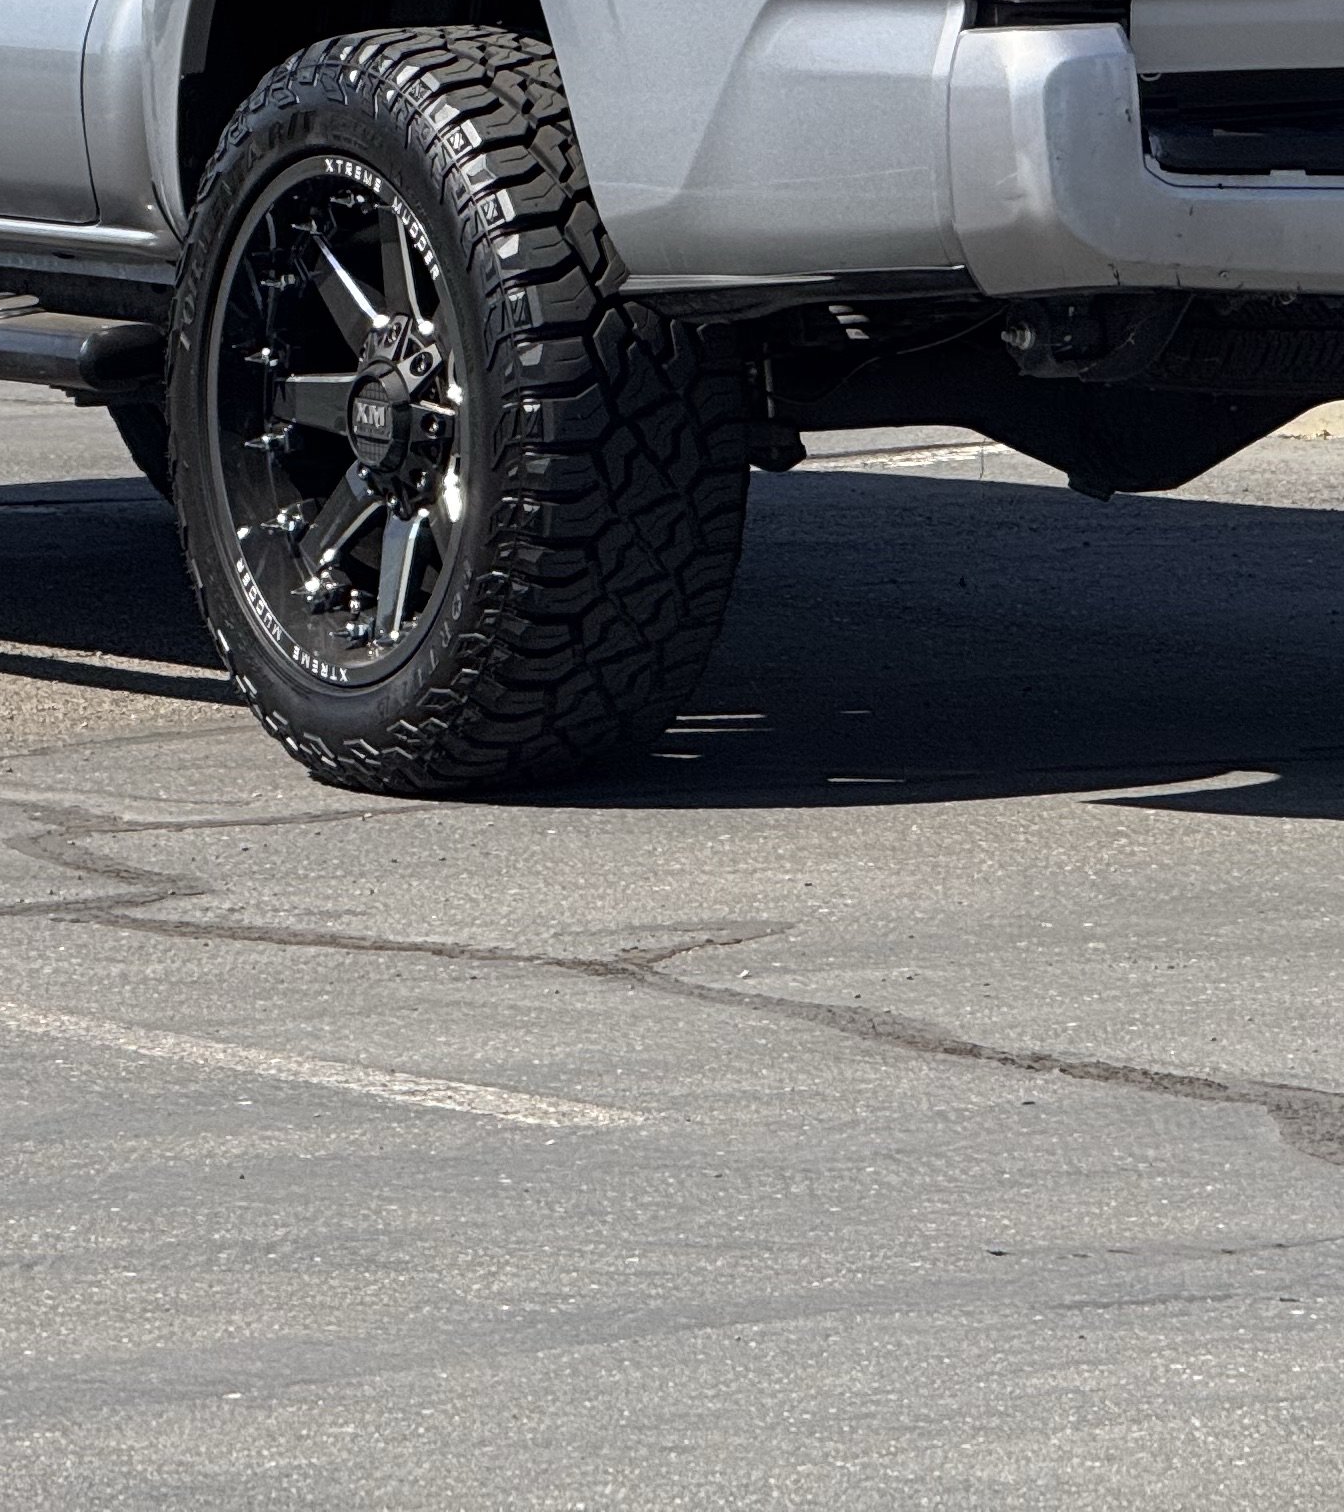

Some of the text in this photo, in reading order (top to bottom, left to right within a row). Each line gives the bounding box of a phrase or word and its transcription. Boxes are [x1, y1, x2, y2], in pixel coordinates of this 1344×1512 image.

[325, 158, 440, 281] XTREME MUDDER
[292, 645, 348, 682] XTREME
